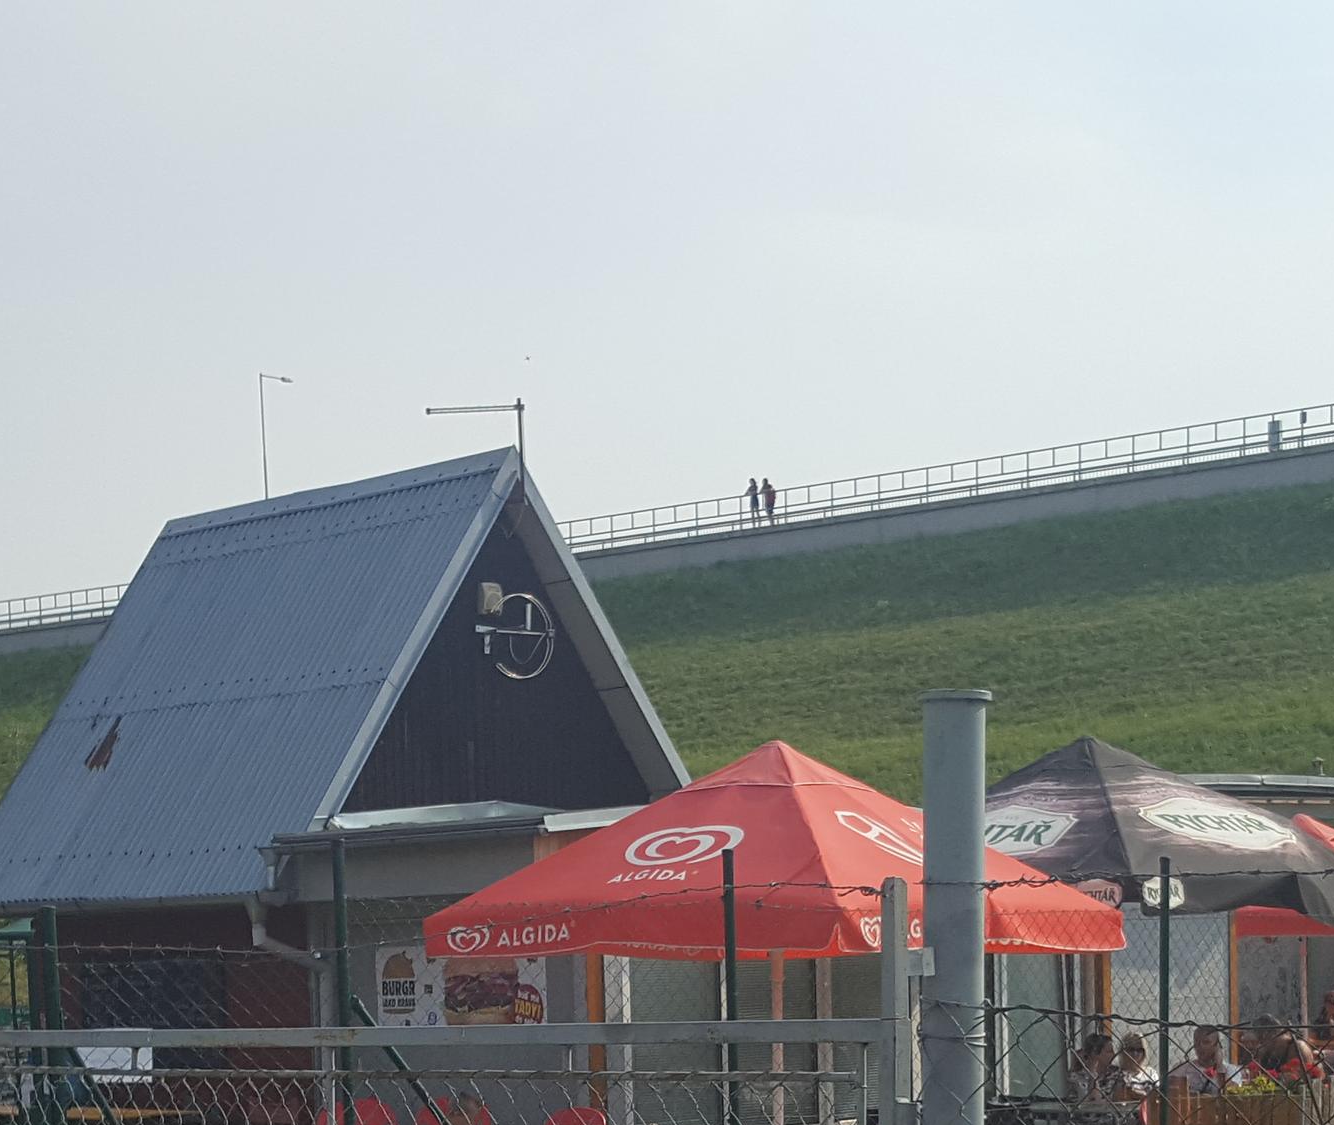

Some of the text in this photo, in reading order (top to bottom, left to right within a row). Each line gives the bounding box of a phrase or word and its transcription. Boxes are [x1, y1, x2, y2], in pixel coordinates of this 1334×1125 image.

[1155, 812, 1279, 835] RYCHTÁŘ
[607, 868, 686, 884] ALGIDA
[497, 922, 569, 948] ALGIDA
[382, 980, 416, 996] BURGR
